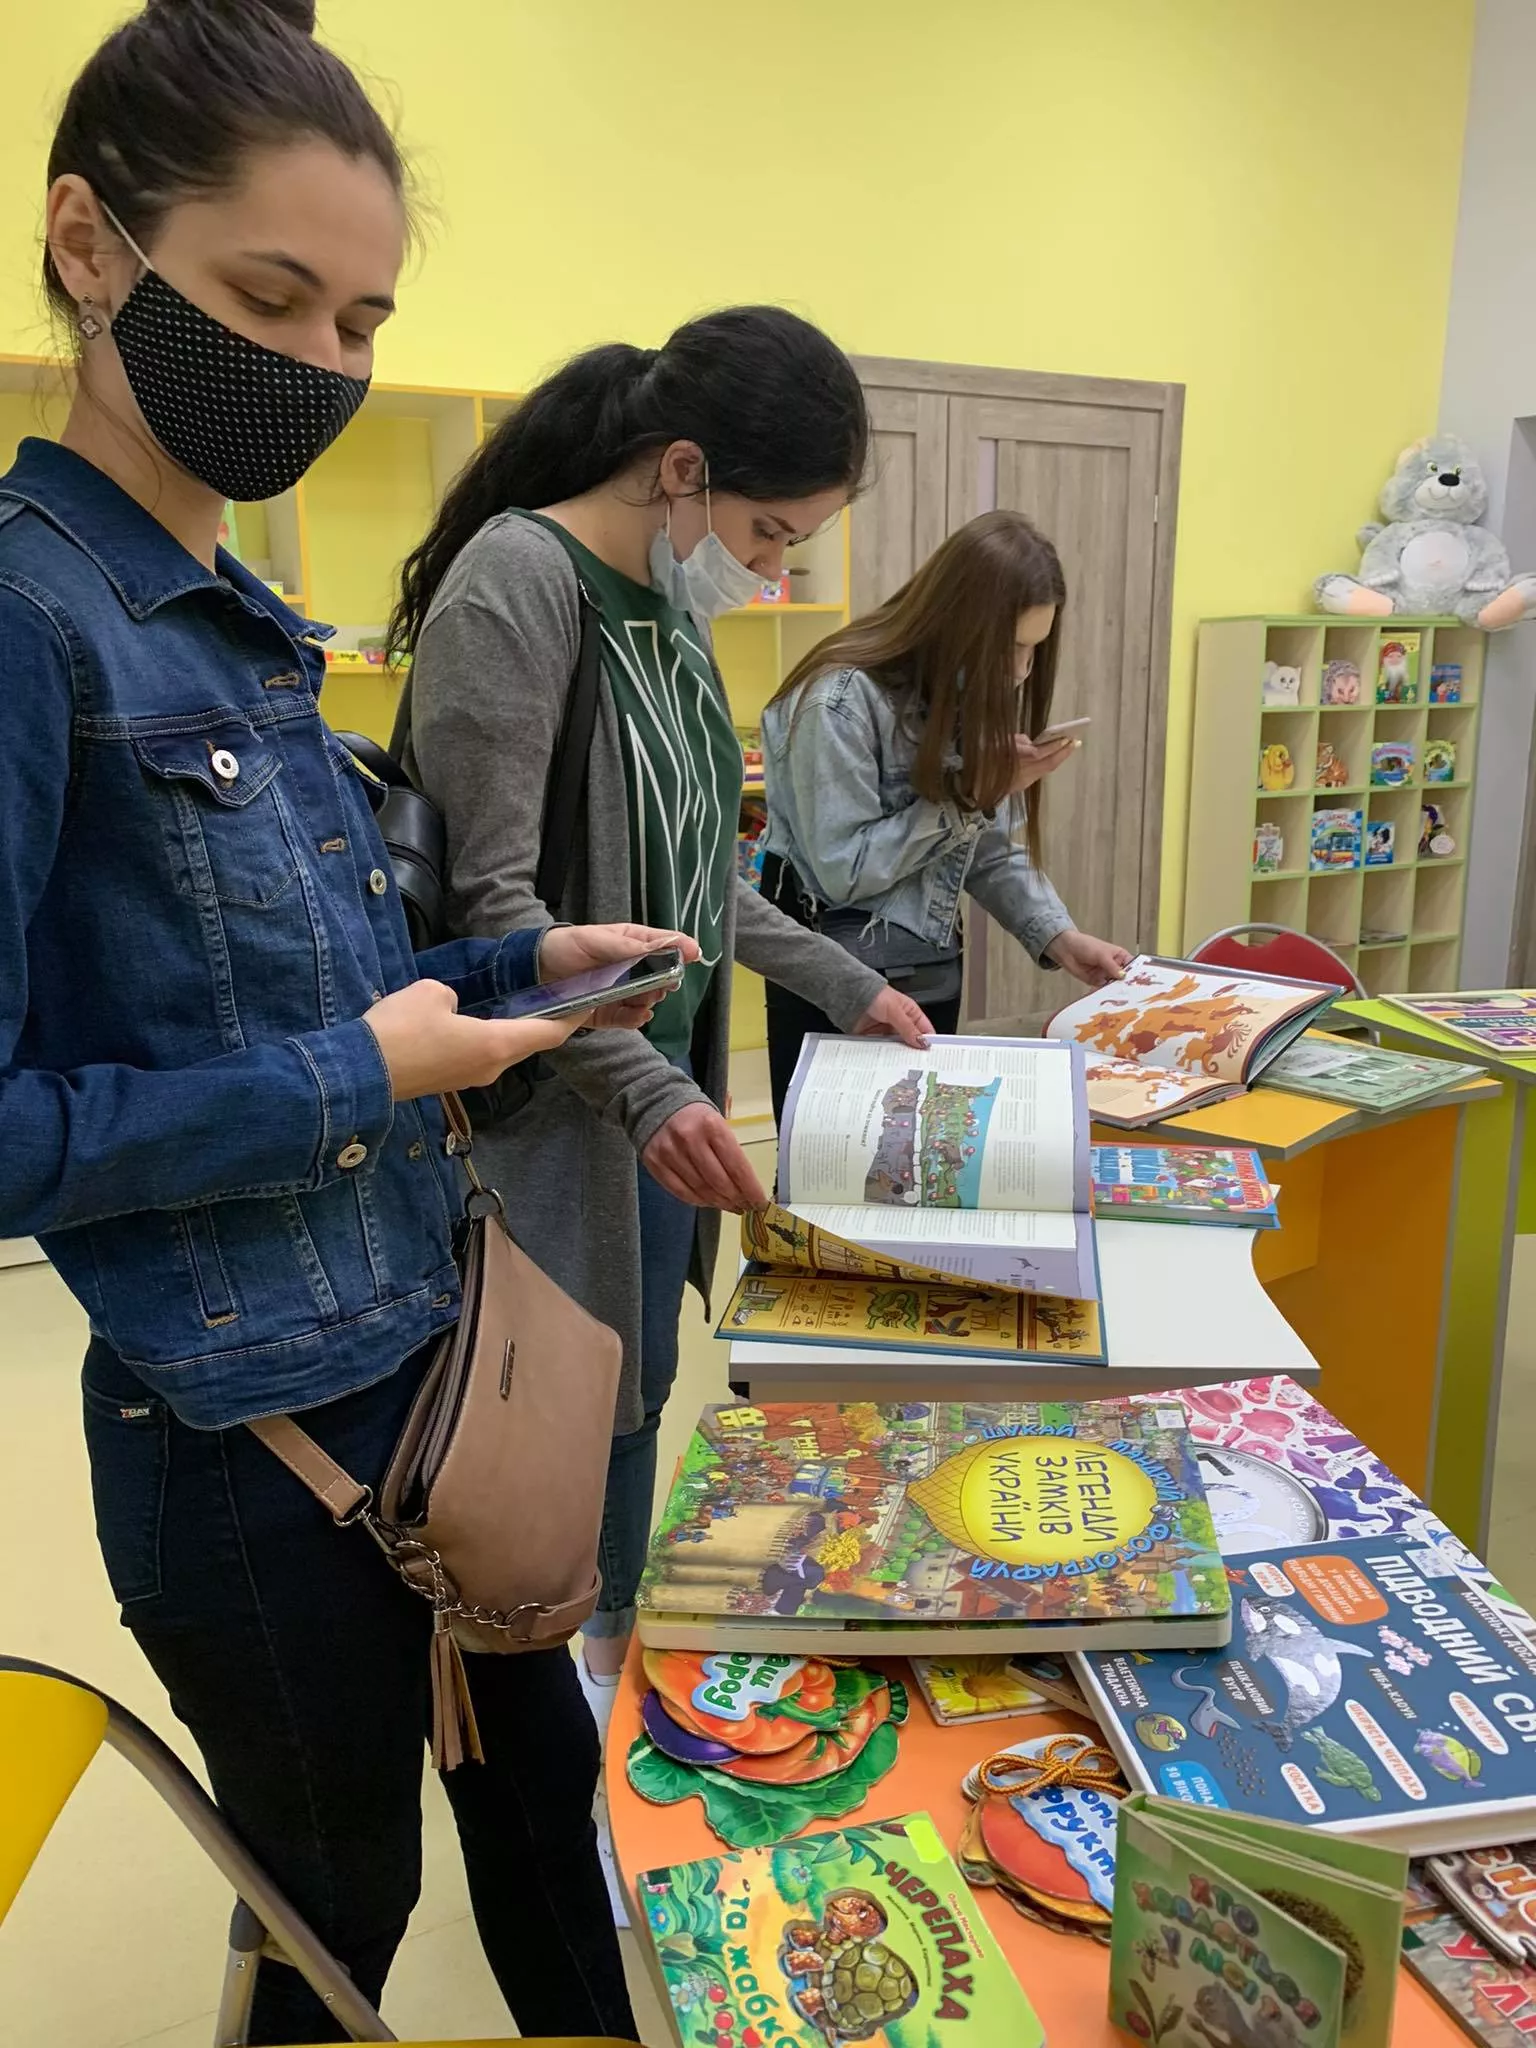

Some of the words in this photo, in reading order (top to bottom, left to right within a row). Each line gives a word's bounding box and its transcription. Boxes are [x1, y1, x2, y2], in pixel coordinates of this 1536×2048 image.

[981, 1423, 1079, 1441] ШУКАЙ
[1035, 1455, 1074, 1536] ЗАМКІВ
[1074, 1449, 1120, 1543] ЛЕГЕНДИ
[1106, 1439, 1188, 1502] МАНДРУЙ
[988, 1451, 1032, 1543] УКРАЇНИ
[969, 1522, 1172, 1581] ФОТОГРАФУЙ
[1364, 1555, 1520, 1685] ПІДВОДНИЙ
[1460, 1591, 1514, 1639] МАЛЕНЬКІ
[703, 1652, 751, 1711] ород
[750, 1653, 790, 1688] аш
[1100, 1663, 1131, 1707] ТРИДАКНА
[1113, 1657, 1149, 1709] ВЕЛЕТЕНСЬКА
[1221, 1676, 1248, 1702] ВУГОР
[1227, 1660, 1275, 1716] ПЕЛІКАНОВИЙ
[1369, 1667, 1418, 1719] РИБА-КЛОУН
[1173, 1781, 1197, 1803] ВІКО
[1285, 1765, 1322, 1811] КОСАТКА
[1384, 1748, 1424, 1797] ЧЕРЕПАХА
[1028, 1785, 1116, 1886] фрукт
[726, 1896, 750, 1930] та
[884, 1860, 974, 2020] ЧЕРЕПАХА
